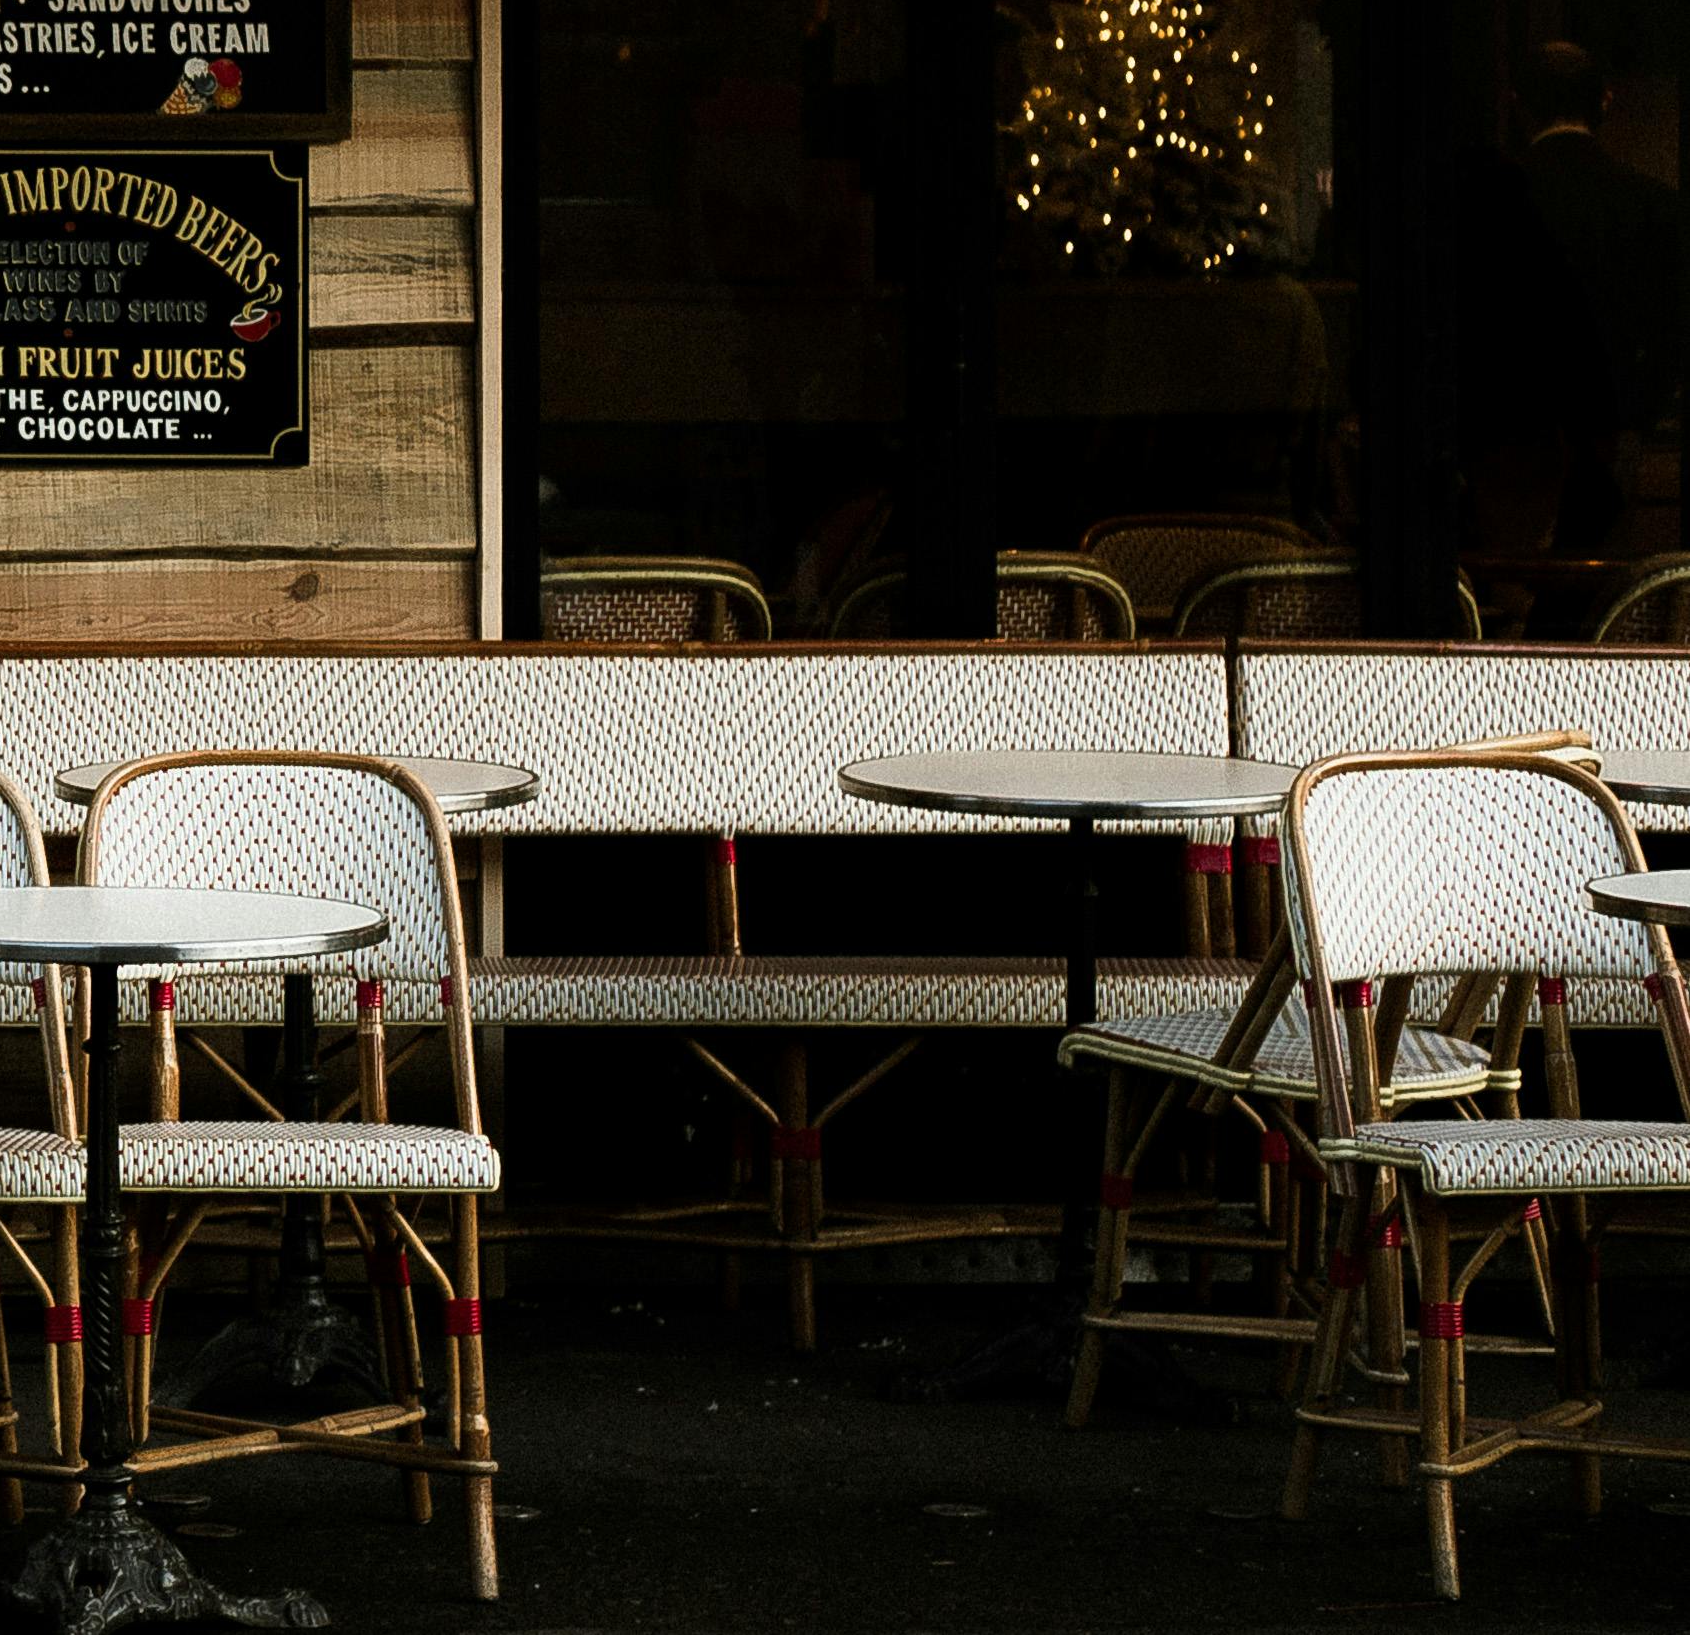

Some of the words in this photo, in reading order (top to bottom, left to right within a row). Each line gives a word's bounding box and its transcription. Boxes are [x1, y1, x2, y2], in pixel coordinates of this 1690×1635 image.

[111, 21, 156, 55] ICE
[169, 21, 270, 55] CREAM
[117, 242, 150, 266] OF
[175, 195, 282, 294] BEERS
[2, 270, 82, 293] WINES
[94, 270, 124, 294] BY
[64, 298, 121, 323] AND
[127, 300, 207, 323] SPIRITS
[18, 346, 120, 379] FRUIT
[132, 348, 247, 380] JUICES
[62, 389, 230, 415] CAPPUCCINO,
[18, 416, 181, 441] CHOCOLATE
